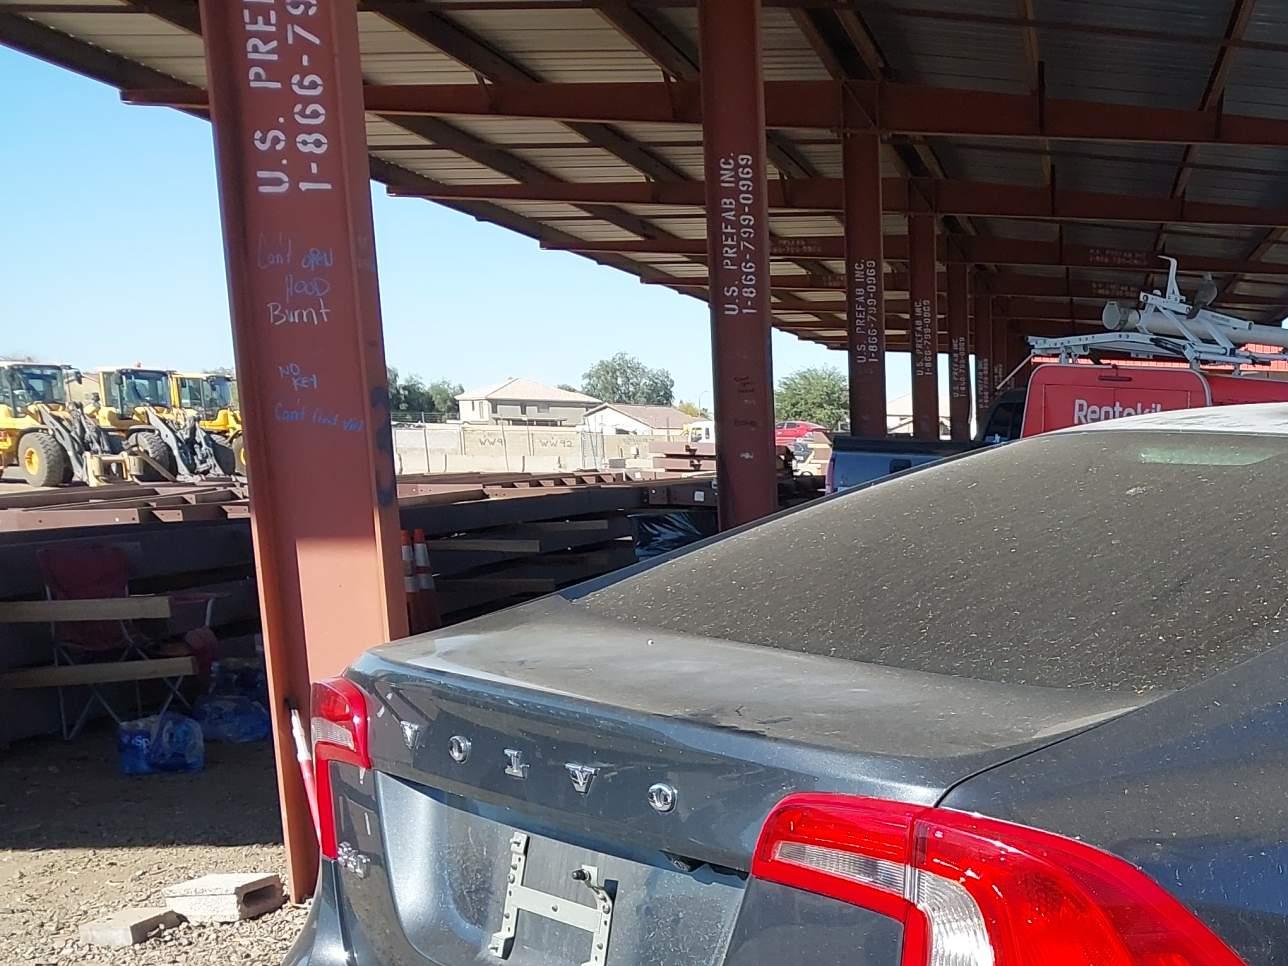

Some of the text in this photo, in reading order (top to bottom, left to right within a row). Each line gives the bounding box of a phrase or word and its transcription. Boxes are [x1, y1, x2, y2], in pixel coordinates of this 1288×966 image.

[240, 0, 289, 193] U.S. PRE
[719, 152, 739, 315] U.S. PREFAB INC.
[738, 154, 757, 314] 1-866-799-0969
[266, 297, 331, 326] Burnt
[855, 288, 866, 334] PREFAB
[866, 260, 879, 362] 1-866-799-0969
[400, 718, 680, 814] VOLVO
